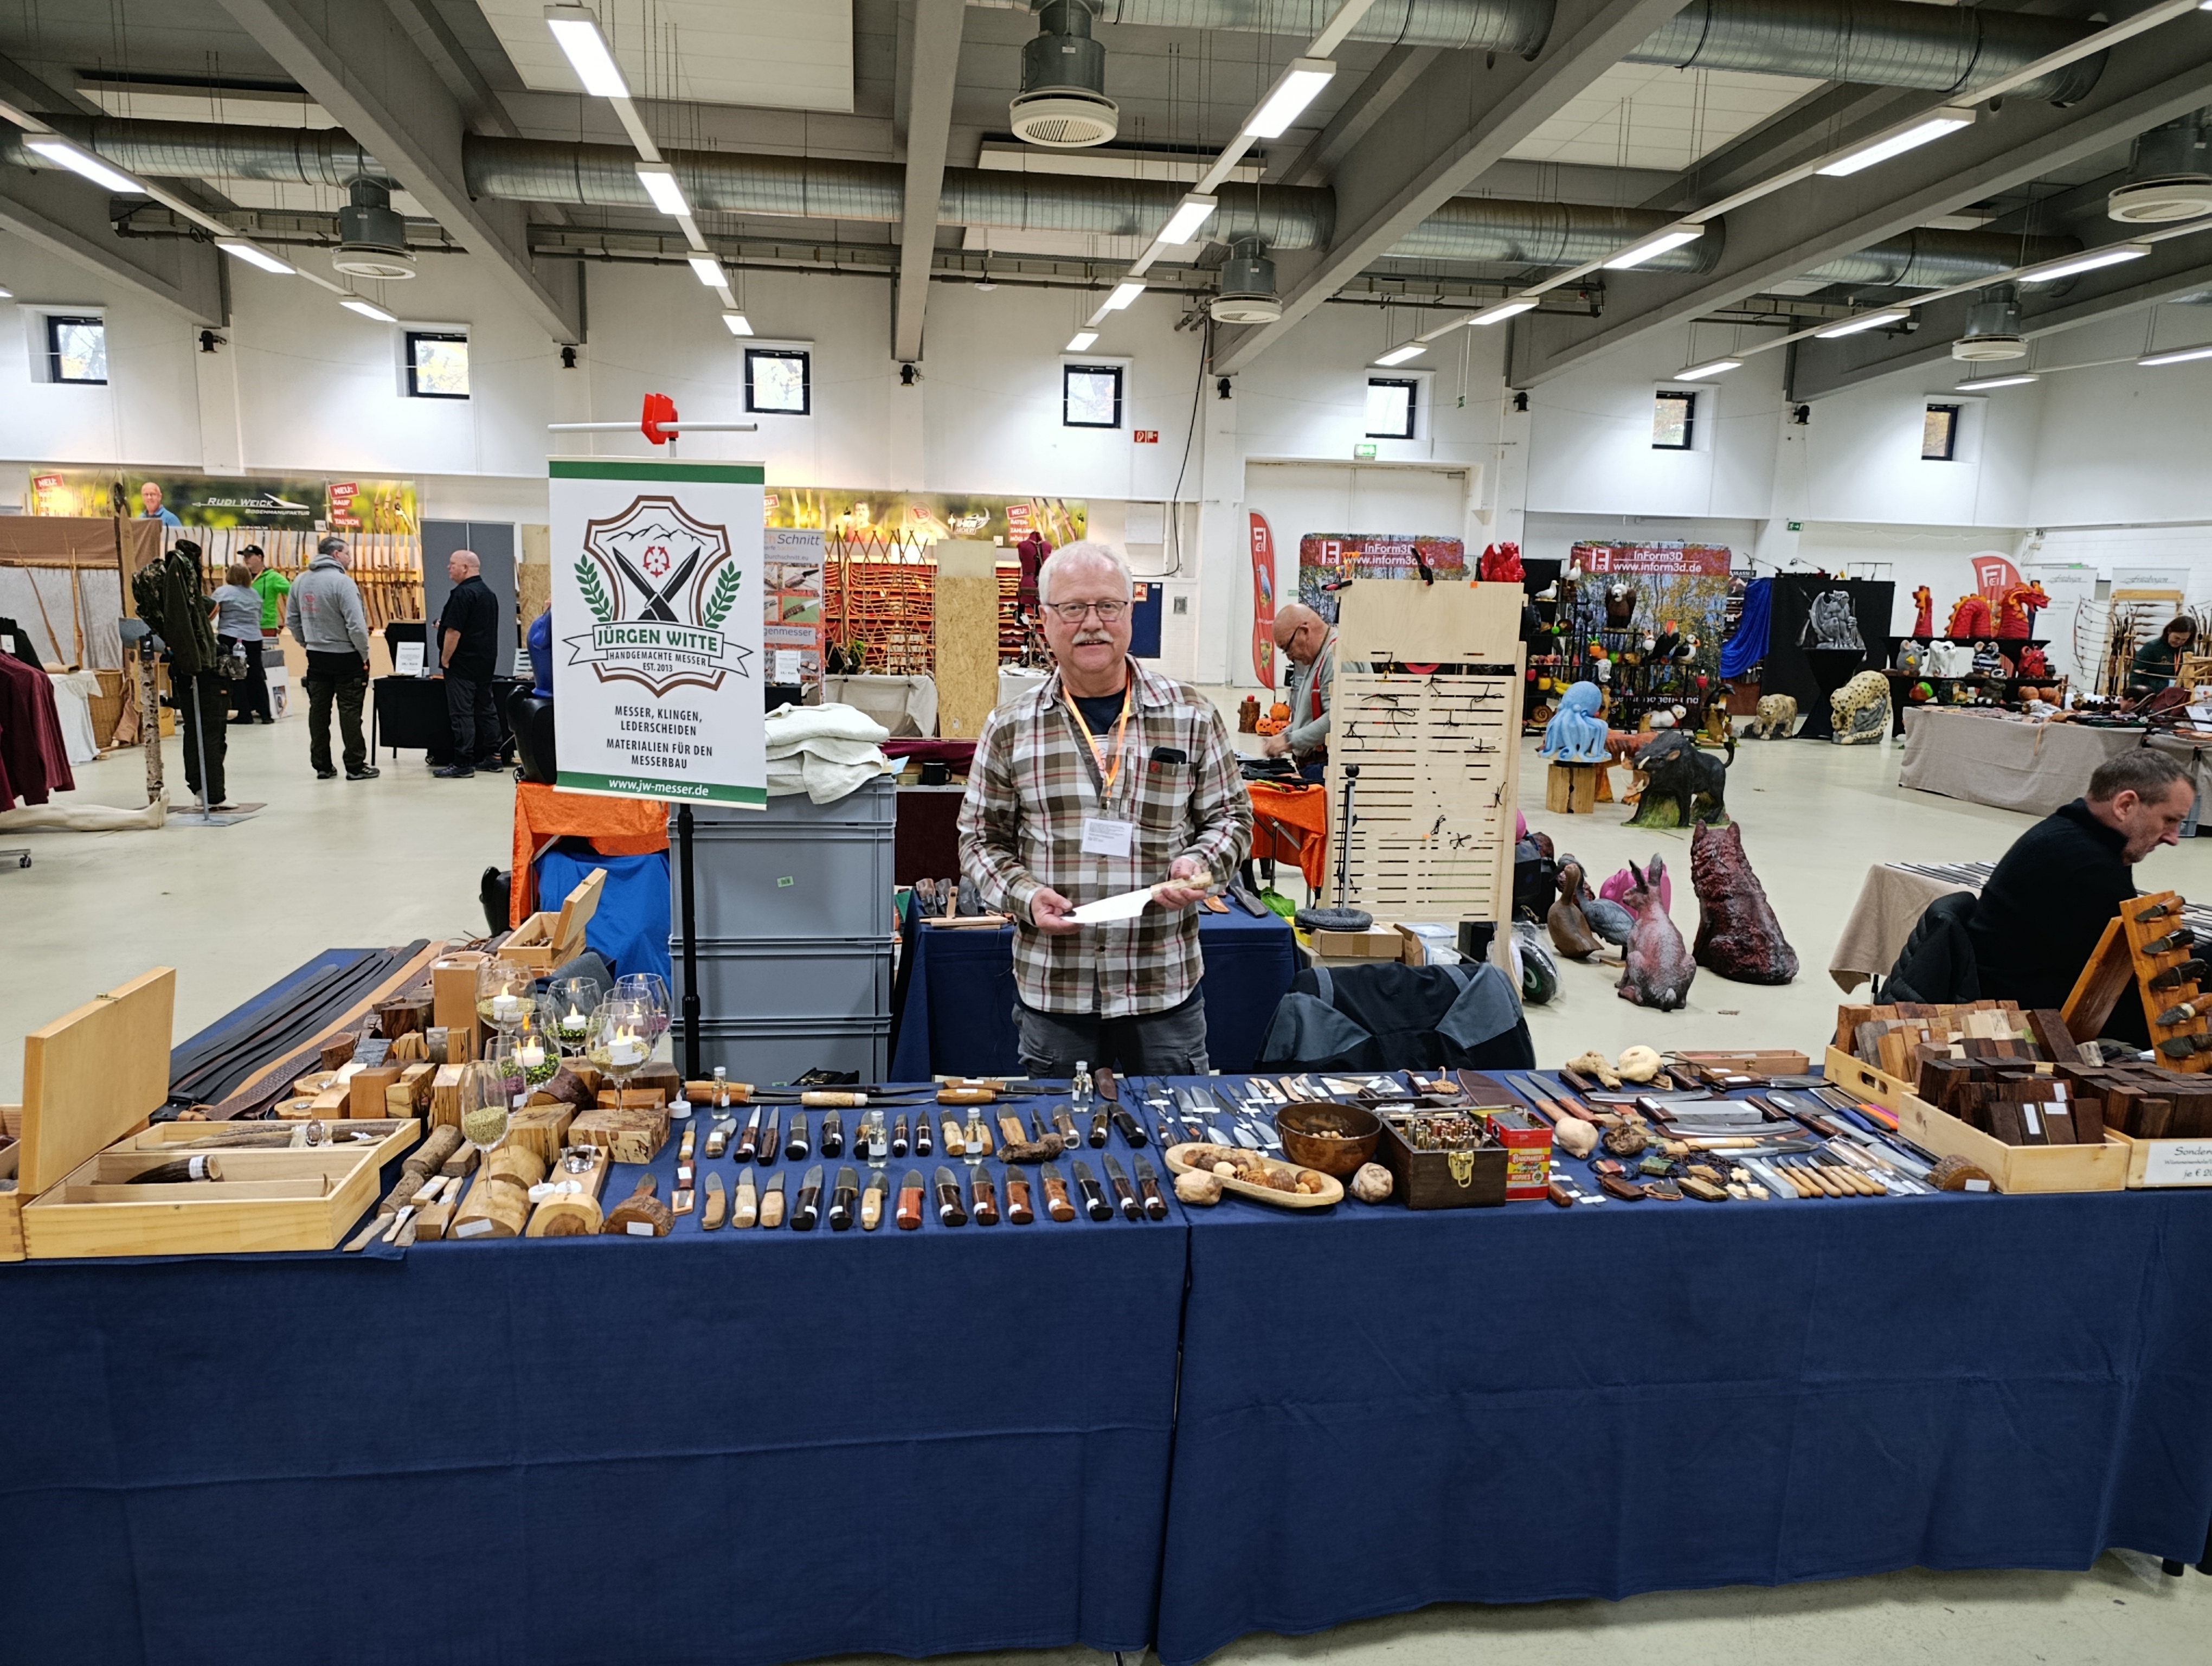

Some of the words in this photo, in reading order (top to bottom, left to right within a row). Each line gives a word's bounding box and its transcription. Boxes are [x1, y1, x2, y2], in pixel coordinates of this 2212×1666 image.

[334, 486, 353, 495] NEU:
[1011, 508, 1027, 516] NEU:
[1634, 551, 1683, 561] InForm3D
[1613, 563, 1702, 573] www.inform3d.de
[598, 626, 660, 646] JÜRGEN
[667, 631, 717, 652] WITTE
[610, 651, 672, 661] HANDGEMACHTE
[676, 654, 706, 666] MESSER
[643, 663, 655, 671] EST.
[657, 664, 673, 672] 2013
[615, 706, 654, 719] MESSER,
[658, 709, 702, 723] KLINGEN,
[621, 721, 696, 736] LEDERSCHEIDEN
[607, 738, 668, 753] MATERIALIEN
[672, 742, 690, 754] FÜR
[694, 745, 712, 757] DEN
[632, 754, 687, 769] MESSERBAU
[609, 779, 709, 796] www.jw-messer.de
[2182, 1170, 2192, 1180] je
